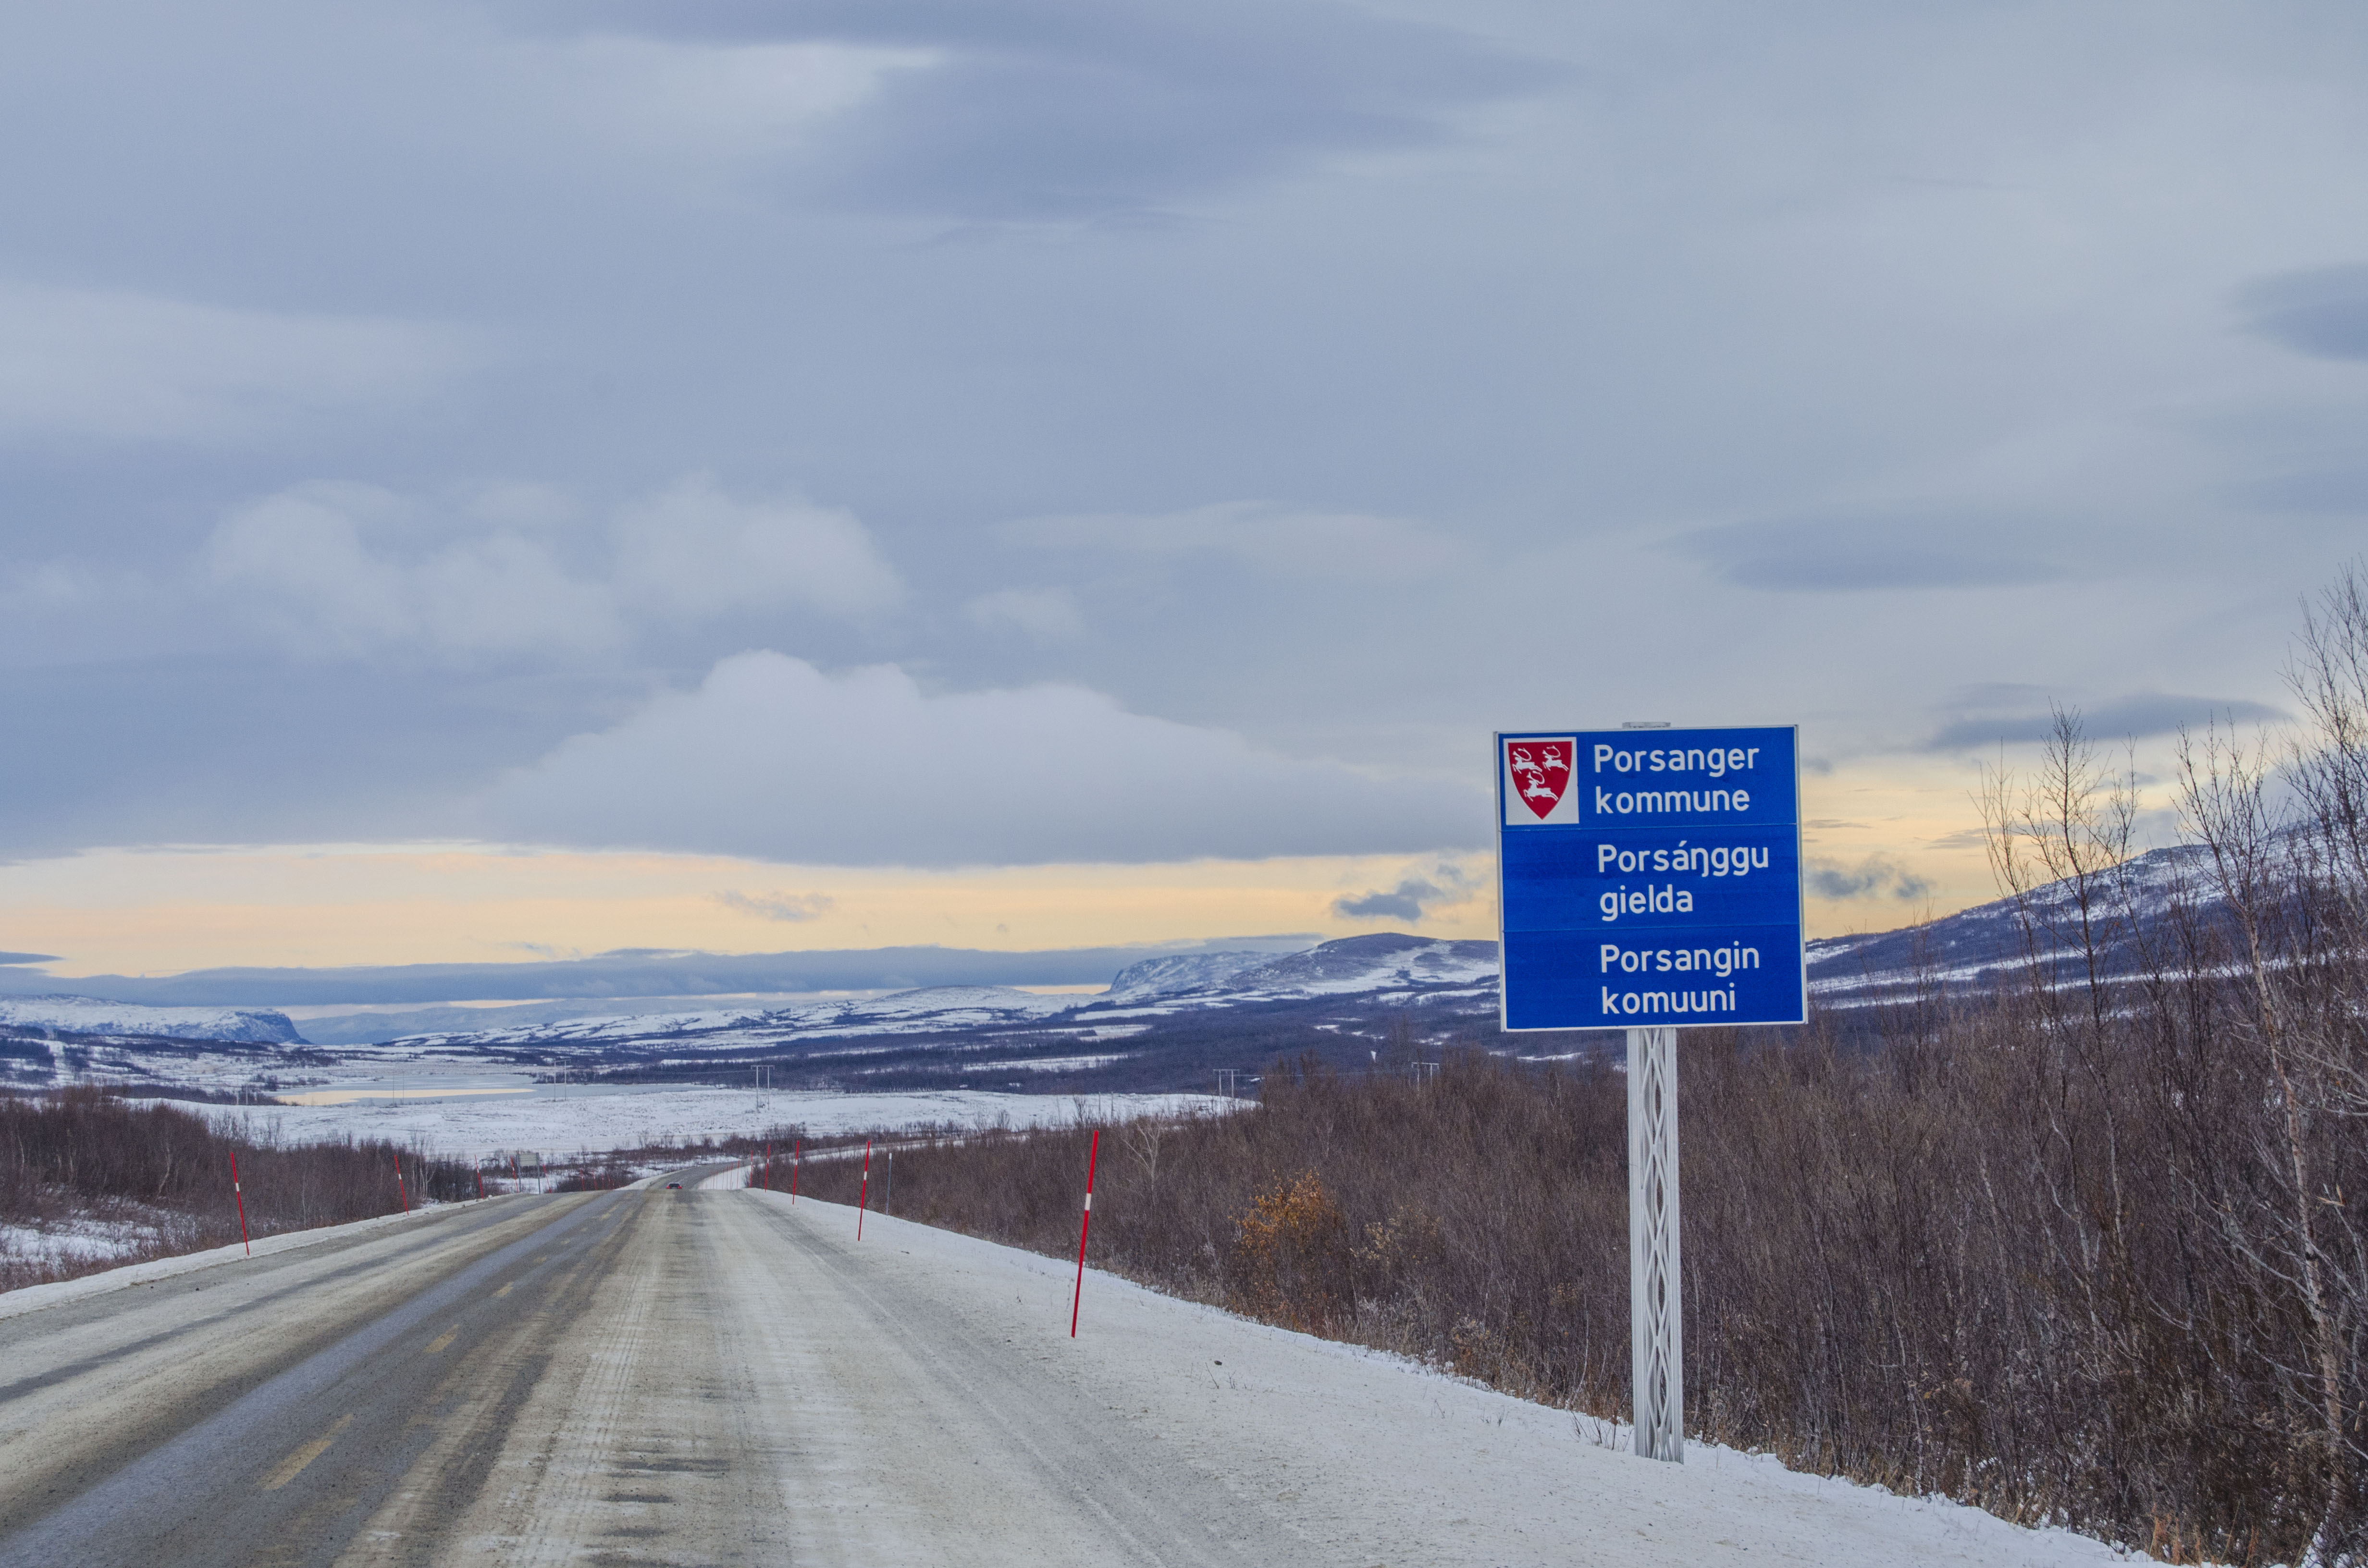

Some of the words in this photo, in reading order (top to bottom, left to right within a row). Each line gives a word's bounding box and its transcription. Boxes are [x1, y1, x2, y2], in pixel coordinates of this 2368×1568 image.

[1594, 745, 1760, 777] Porsanger
[1596, 786, 1750, 814] kommune
[1598, 840, 1768, 877] Porsáŋggu
[1600, 884, 1693, 921] gielda
[1601, 941, 1759, 977] Porsangin
[1602, 982, 1735, 1014] komuuni
